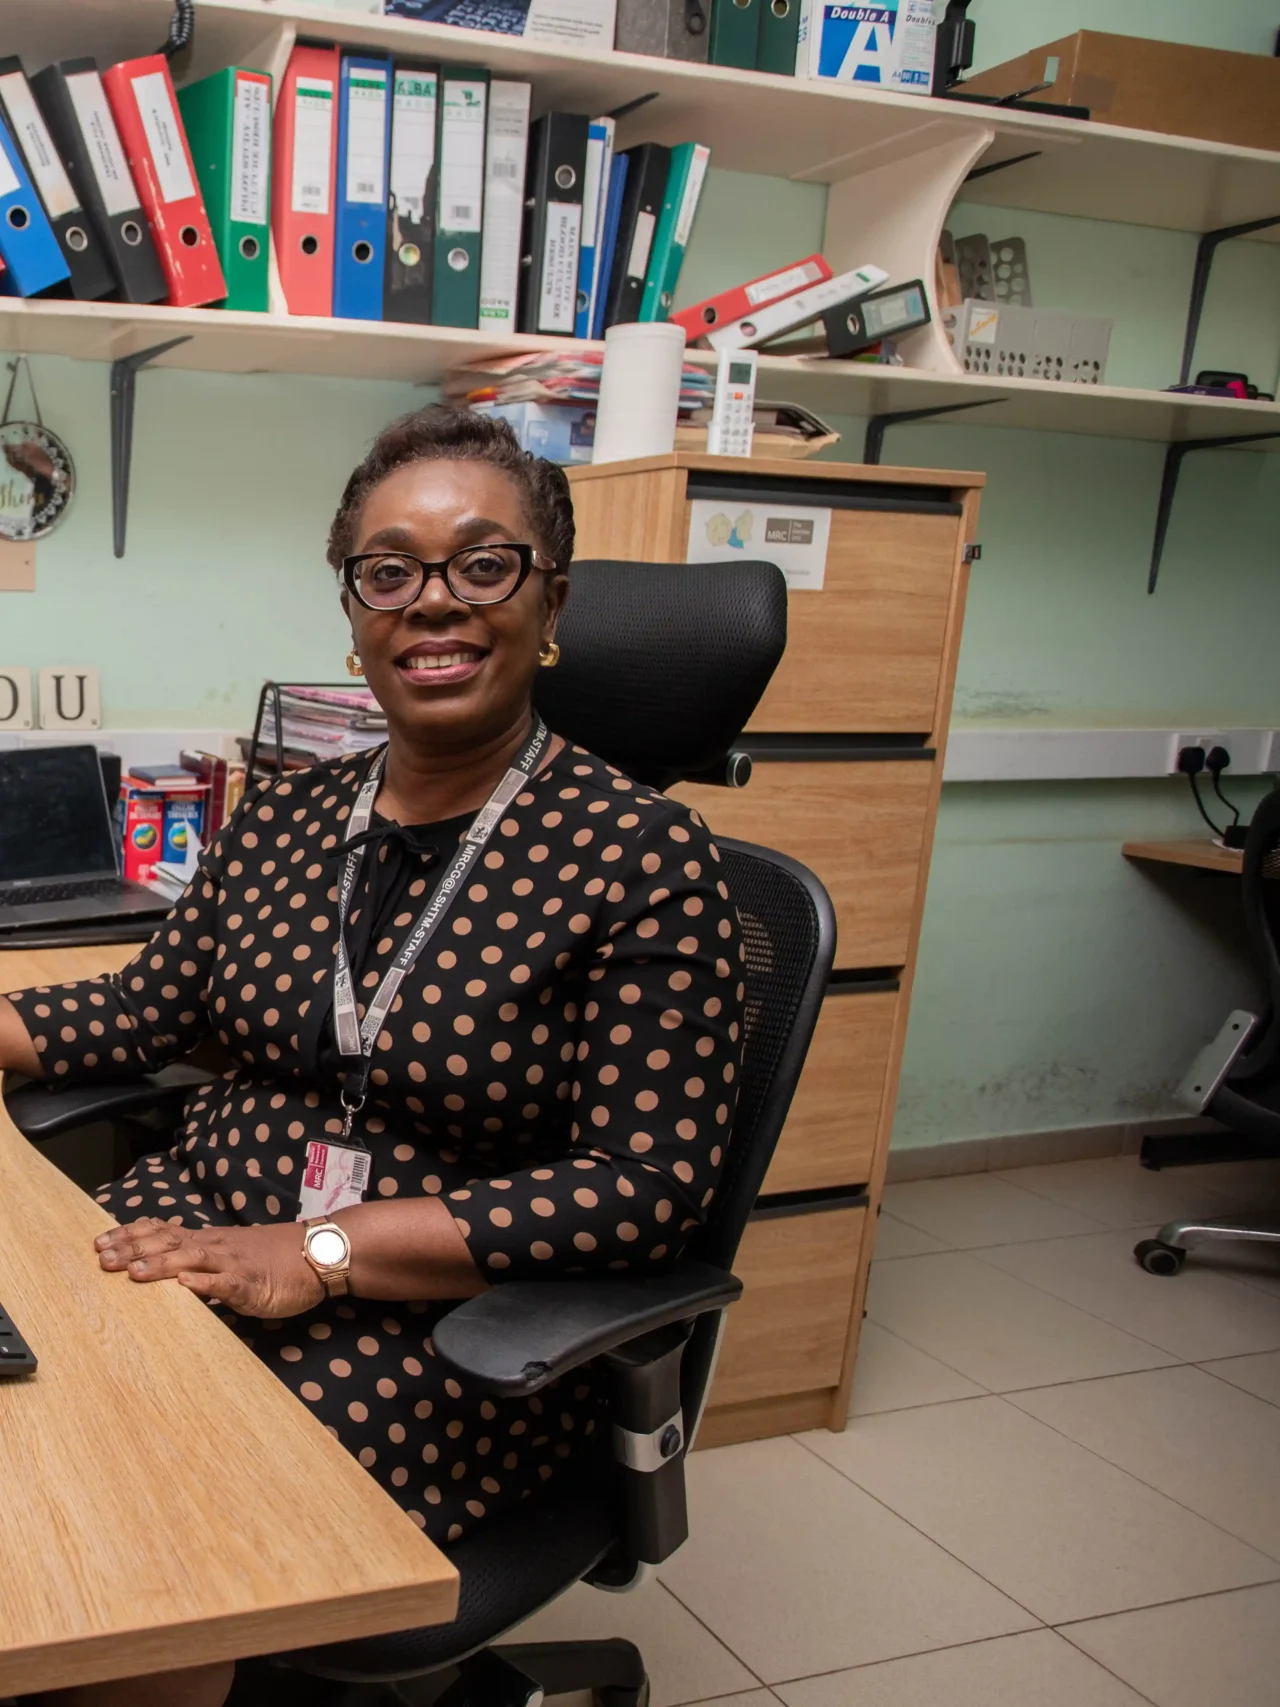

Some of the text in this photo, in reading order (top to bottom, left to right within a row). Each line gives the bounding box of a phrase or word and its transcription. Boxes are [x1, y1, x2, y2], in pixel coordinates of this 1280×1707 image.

[830, 6, 890, 23] Double A
[396, 82, 432, 96] ALBA
[767, 530, 788, 541] MRC
[52, 675, 87, 720] U
[520, 720, 548, 771] HTM-STAFF
[398, 844, 476, 966] MRCG@LSHTM-STAFF
[314, 1168, 323, 1188] MRC
